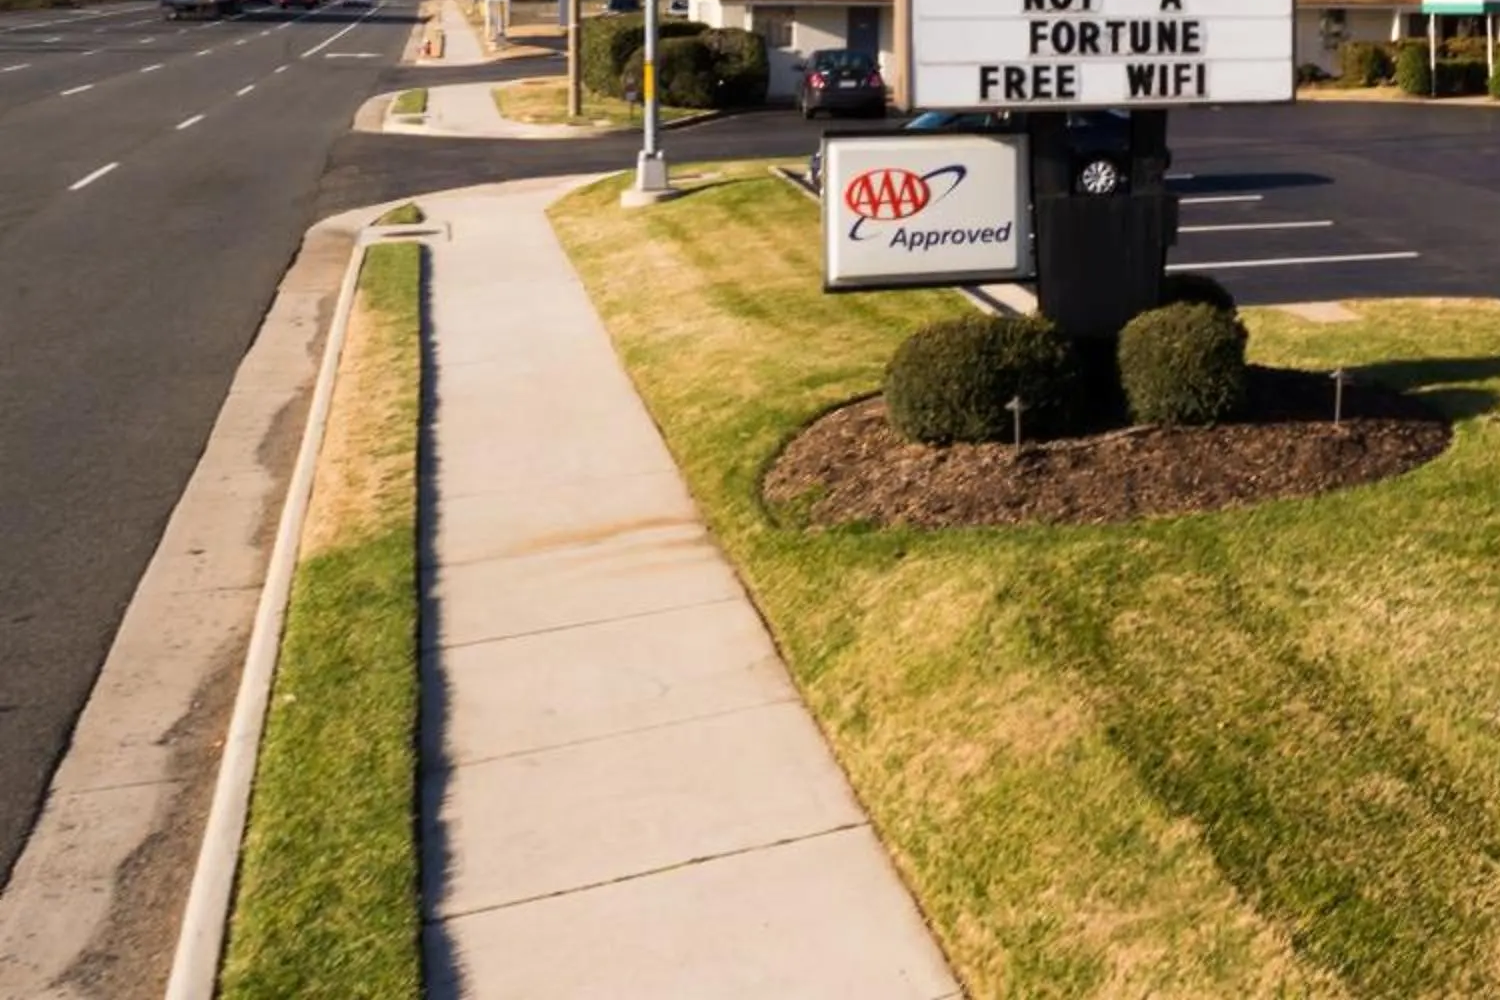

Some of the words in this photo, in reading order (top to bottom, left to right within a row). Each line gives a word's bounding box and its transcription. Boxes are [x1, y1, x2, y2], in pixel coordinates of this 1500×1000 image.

[1029, 20, 1201, 55] FORTUNE
[979, 65, 1076, 100] FREE
[1126, 63, 1206, 98] WIFI
[852, 168, 926, 219] AAA
[889, 221, 1012, 252] Approved
